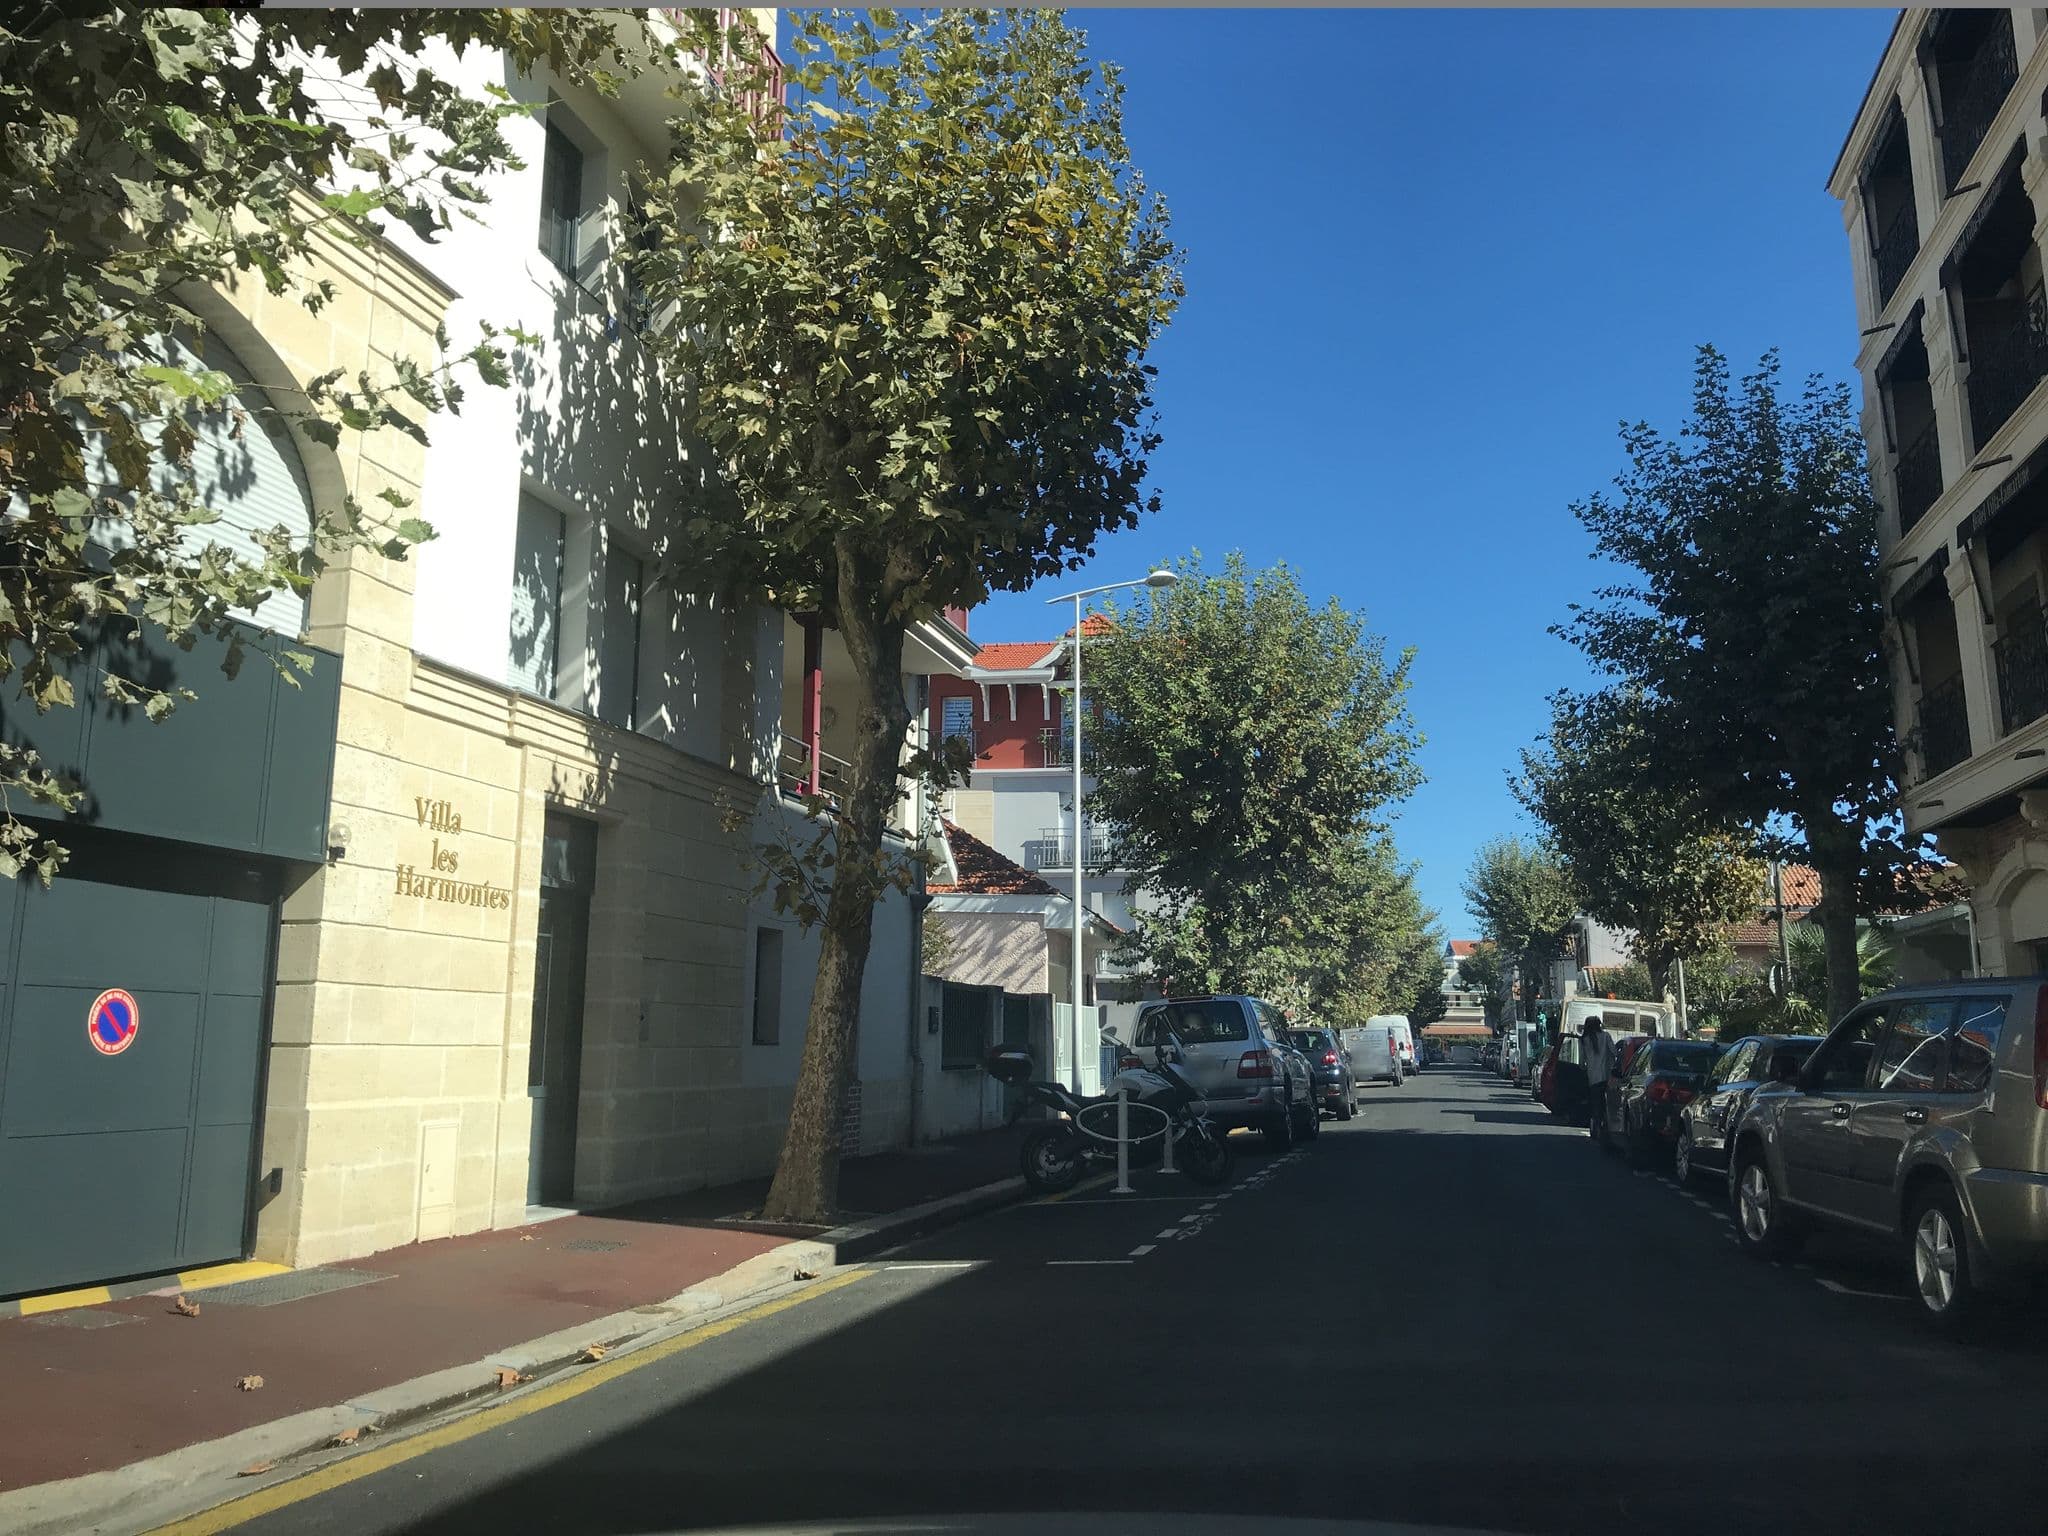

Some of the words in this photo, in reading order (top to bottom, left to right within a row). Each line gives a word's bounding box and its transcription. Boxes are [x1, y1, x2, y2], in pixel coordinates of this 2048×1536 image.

[415, 796, 461, 835] Villa
[431, 838, 458, 873] les
[395, 864, 509, 910] Harmonies
